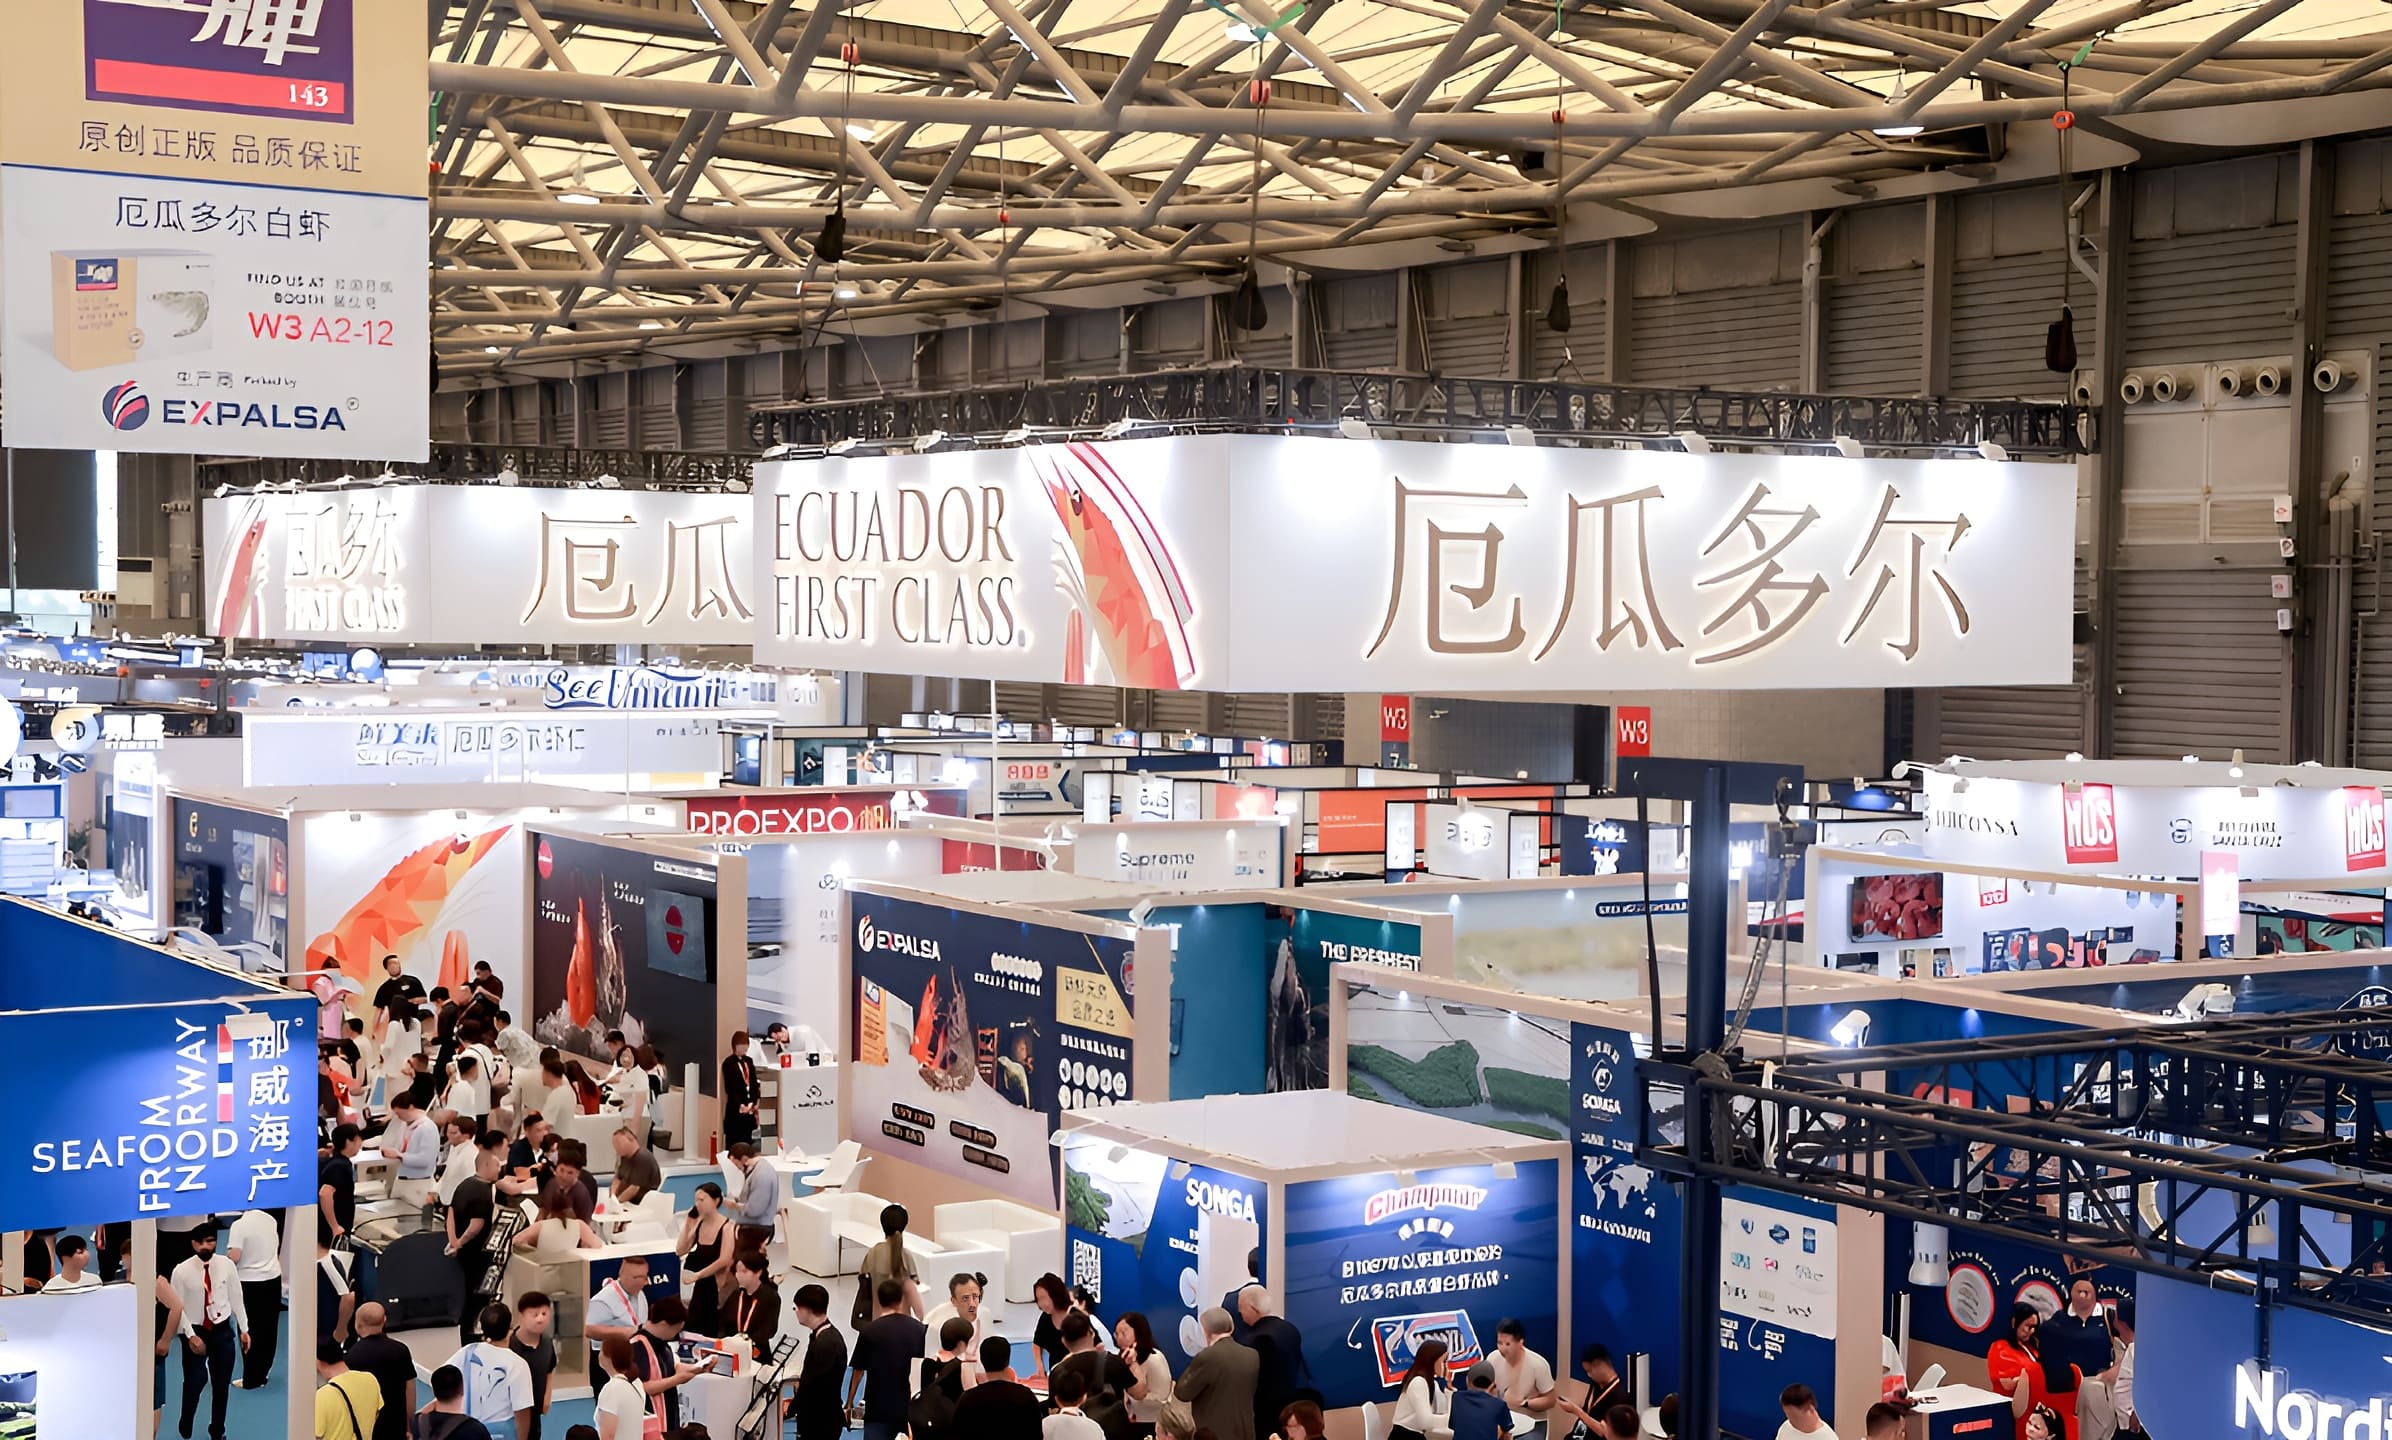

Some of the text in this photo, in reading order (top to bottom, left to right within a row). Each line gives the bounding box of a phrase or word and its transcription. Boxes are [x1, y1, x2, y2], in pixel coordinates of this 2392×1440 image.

[289, 84, 329, 107] 143
[79, 121, 363, 173] 原创正版 品质保证
[115, 196, 332, 241] 厄瓜多尔白虾
[248, 311, 394, 346] W3 A2-12
[162, 399, 347, 431] EXPALSA
[774, 486, 1014, 564] ECUADOR
[1366, 476, 1973, 665] 厄瓜多尔
[774, 575, 878, 641] FIRST
[1384, 706, 1407, 730] W3
[1619, 719, 1649, 745] W3
[175, 1017, 207, 1193] NORWAY
[32, 1128, 239, 1174] SEAFOOD
[139, 1095, 171, 1212] FROM
[1185, 1178, 1257, 1224] SONGA
[2234, 1363, 2392, 1440] Nord
